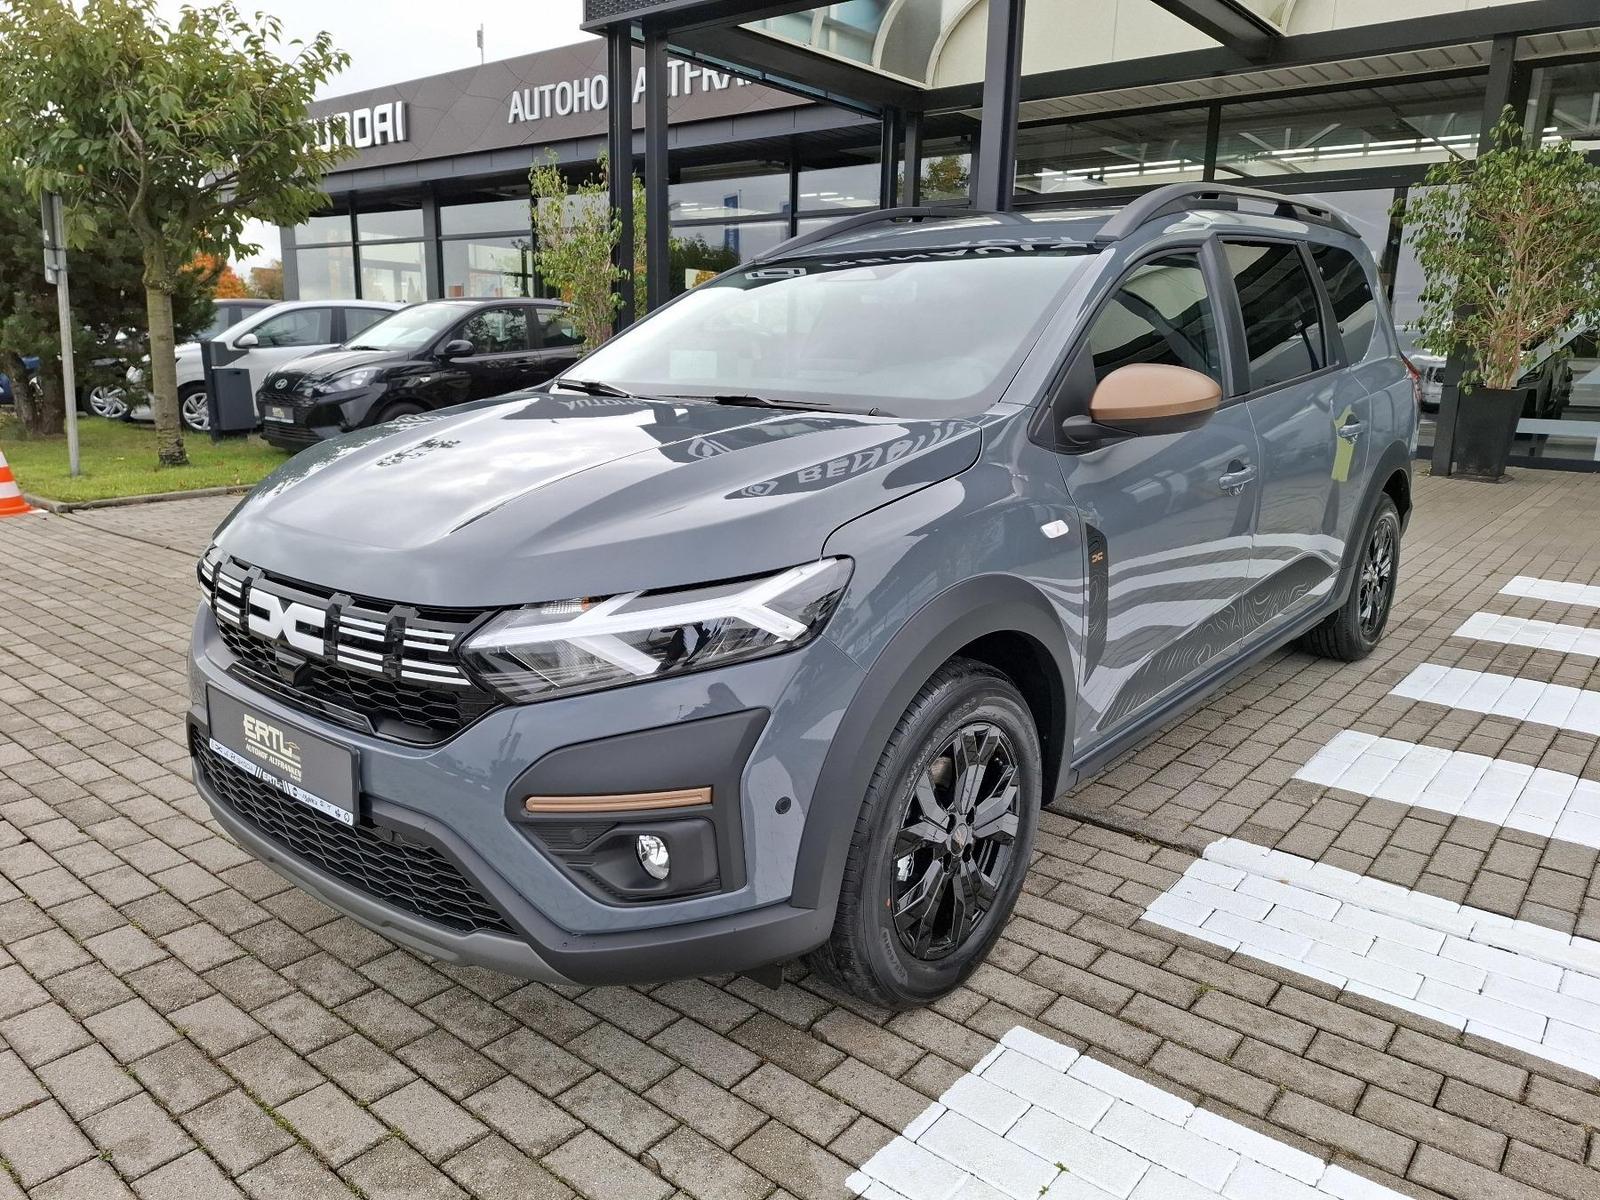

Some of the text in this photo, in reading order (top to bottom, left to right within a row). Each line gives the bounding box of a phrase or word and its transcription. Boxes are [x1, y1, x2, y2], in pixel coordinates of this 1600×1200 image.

[508, 74, 608, 124] AUTOHO
[289, 101, 405, 155] UNDAI
[243, 713, 293, 757] ERTL
